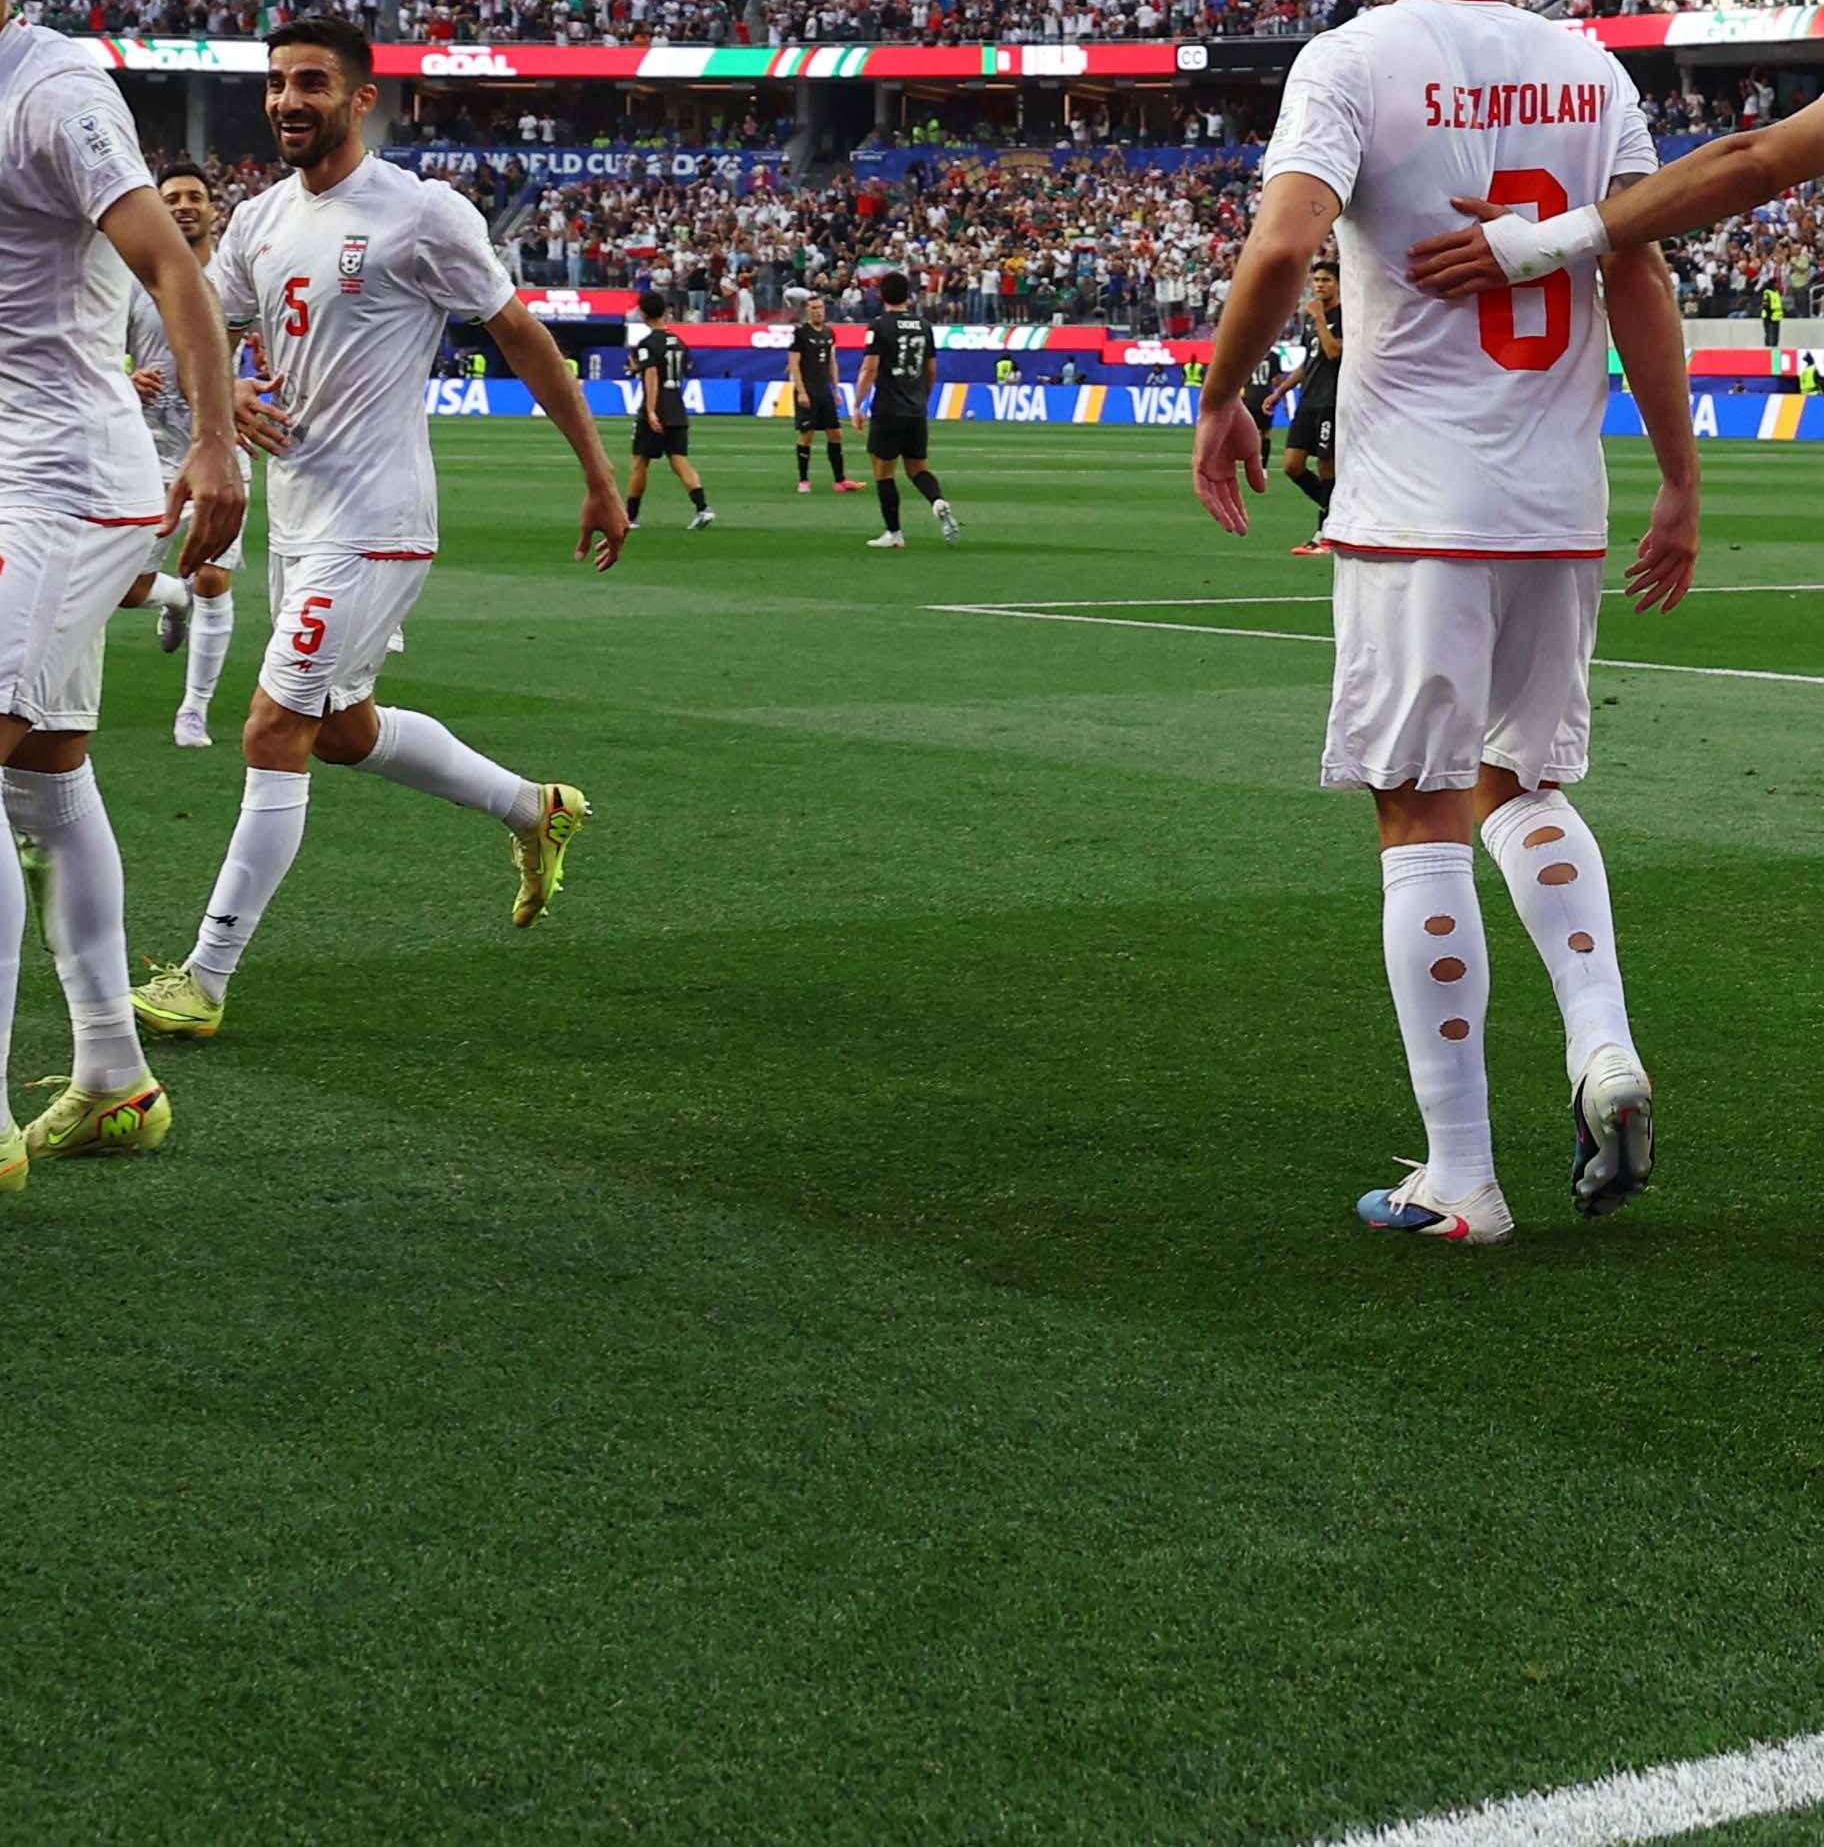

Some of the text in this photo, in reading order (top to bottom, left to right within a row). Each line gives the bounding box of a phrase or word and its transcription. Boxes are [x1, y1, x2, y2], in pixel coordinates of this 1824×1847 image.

[421, 53, 518, 76] GOAL
[1182, 50, 1203, 65] CC
[284, 276, 312, 337] 5
[425, 378, 491, 414] ISA
[985, 385, 1048, 421] VISA
[1125, 386, 1193, 424] VISA
[291, 596, 333, 654] 5
